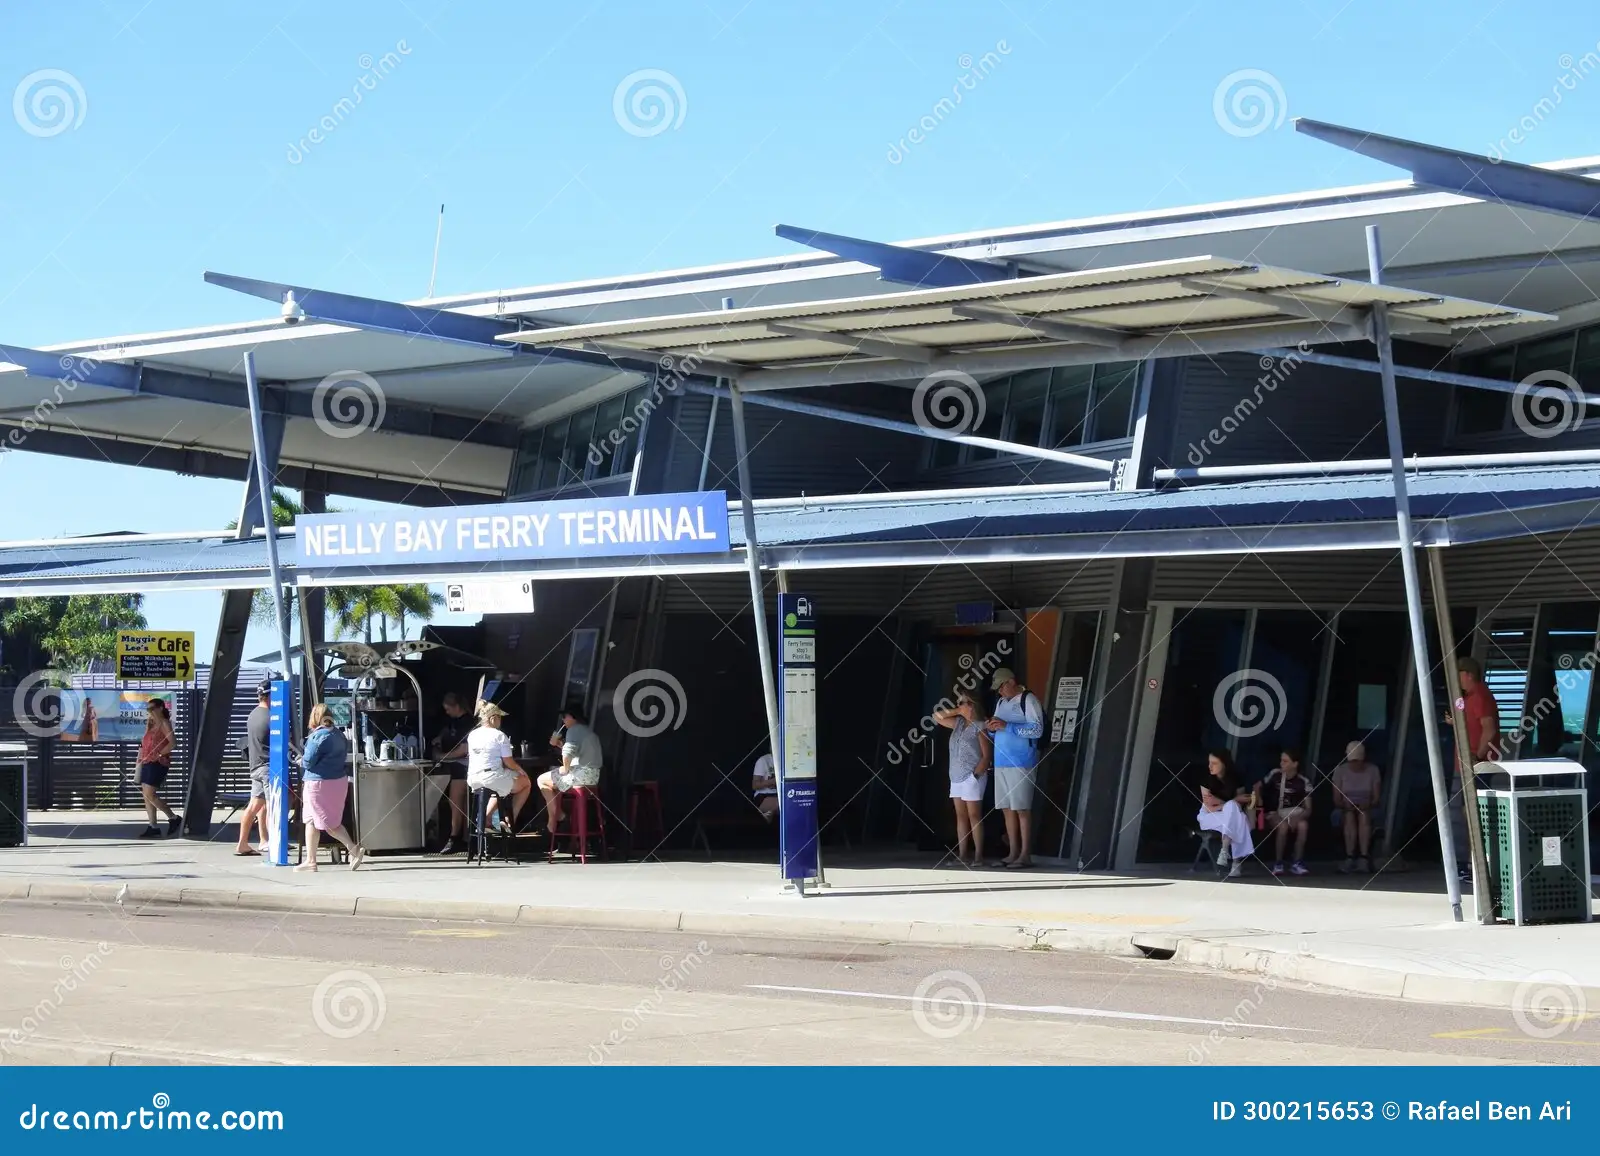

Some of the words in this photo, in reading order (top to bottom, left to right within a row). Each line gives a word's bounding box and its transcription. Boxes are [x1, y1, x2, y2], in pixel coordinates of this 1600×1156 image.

[304, 522, 388, 556] NELLY
[395, 519, 449, 552] BAY
[457, 513, 550, 549] FERRY
[559, 505, 717, 545] TERMINAL
[121, 635, 156, 644] Maggie
[158, 637, 190, 652] Cafe
